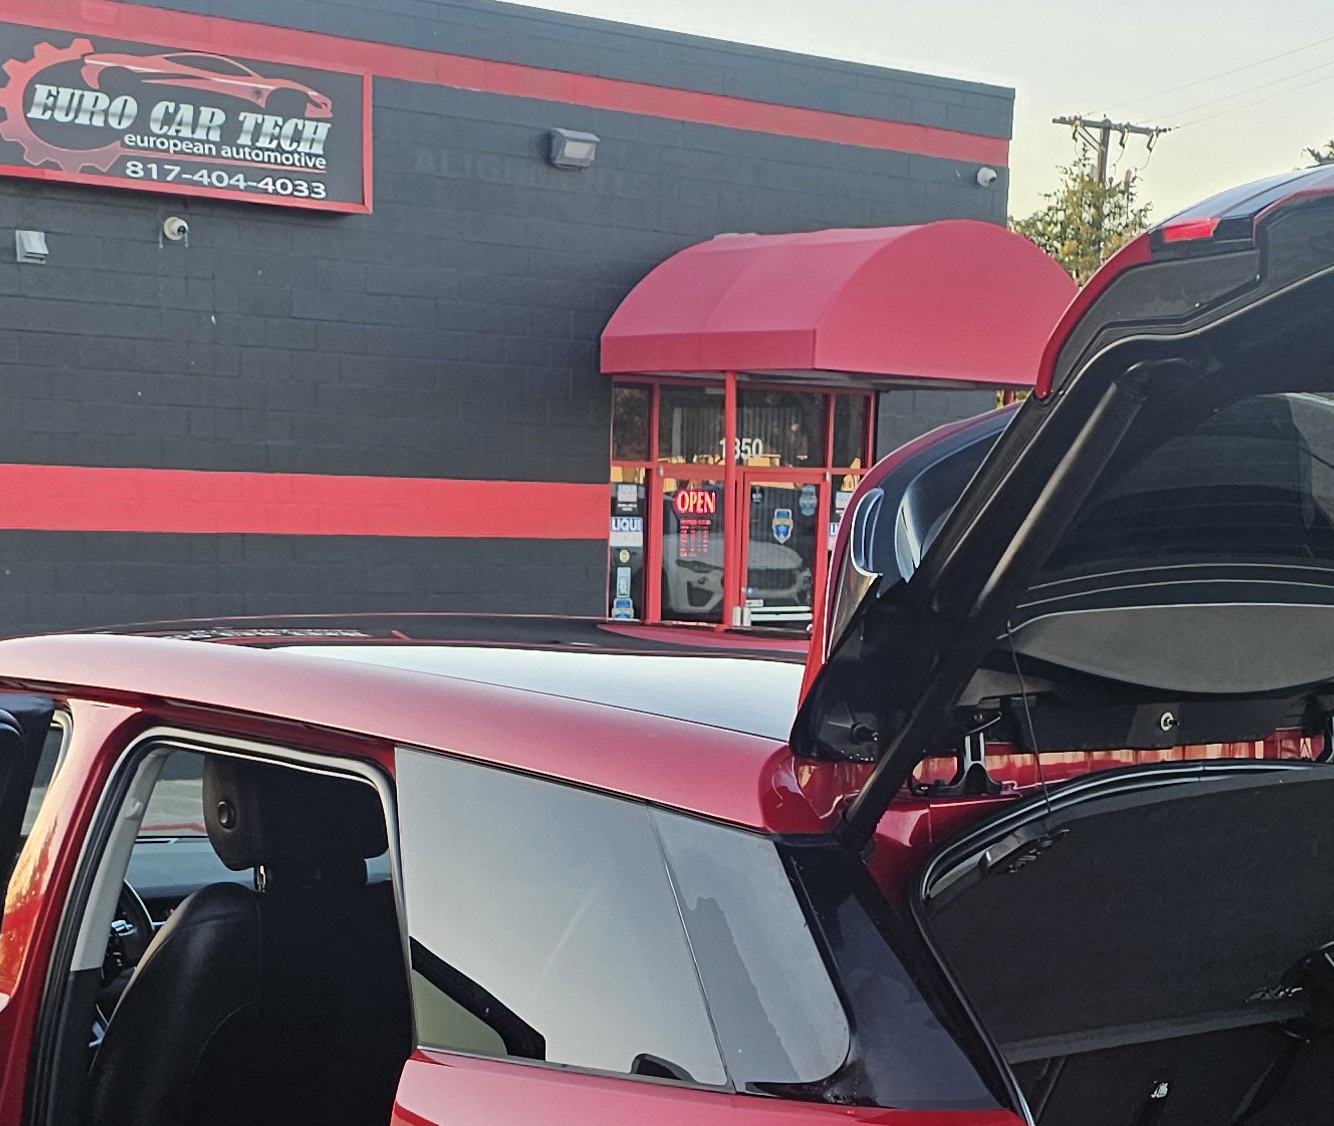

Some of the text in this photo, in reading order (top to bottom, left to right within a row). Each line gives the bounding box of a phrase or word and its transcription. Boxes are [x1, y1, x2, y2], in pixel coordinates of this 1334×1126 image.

[26, 83, 332, 154] EURO CAR TECH
[124, 132, 327, 170] european automotive
[125, 159, 327, 199] 817-404-4033
[676, 489, 716, 514] OPEN
[611, 518, 642, 531] LIQUI
